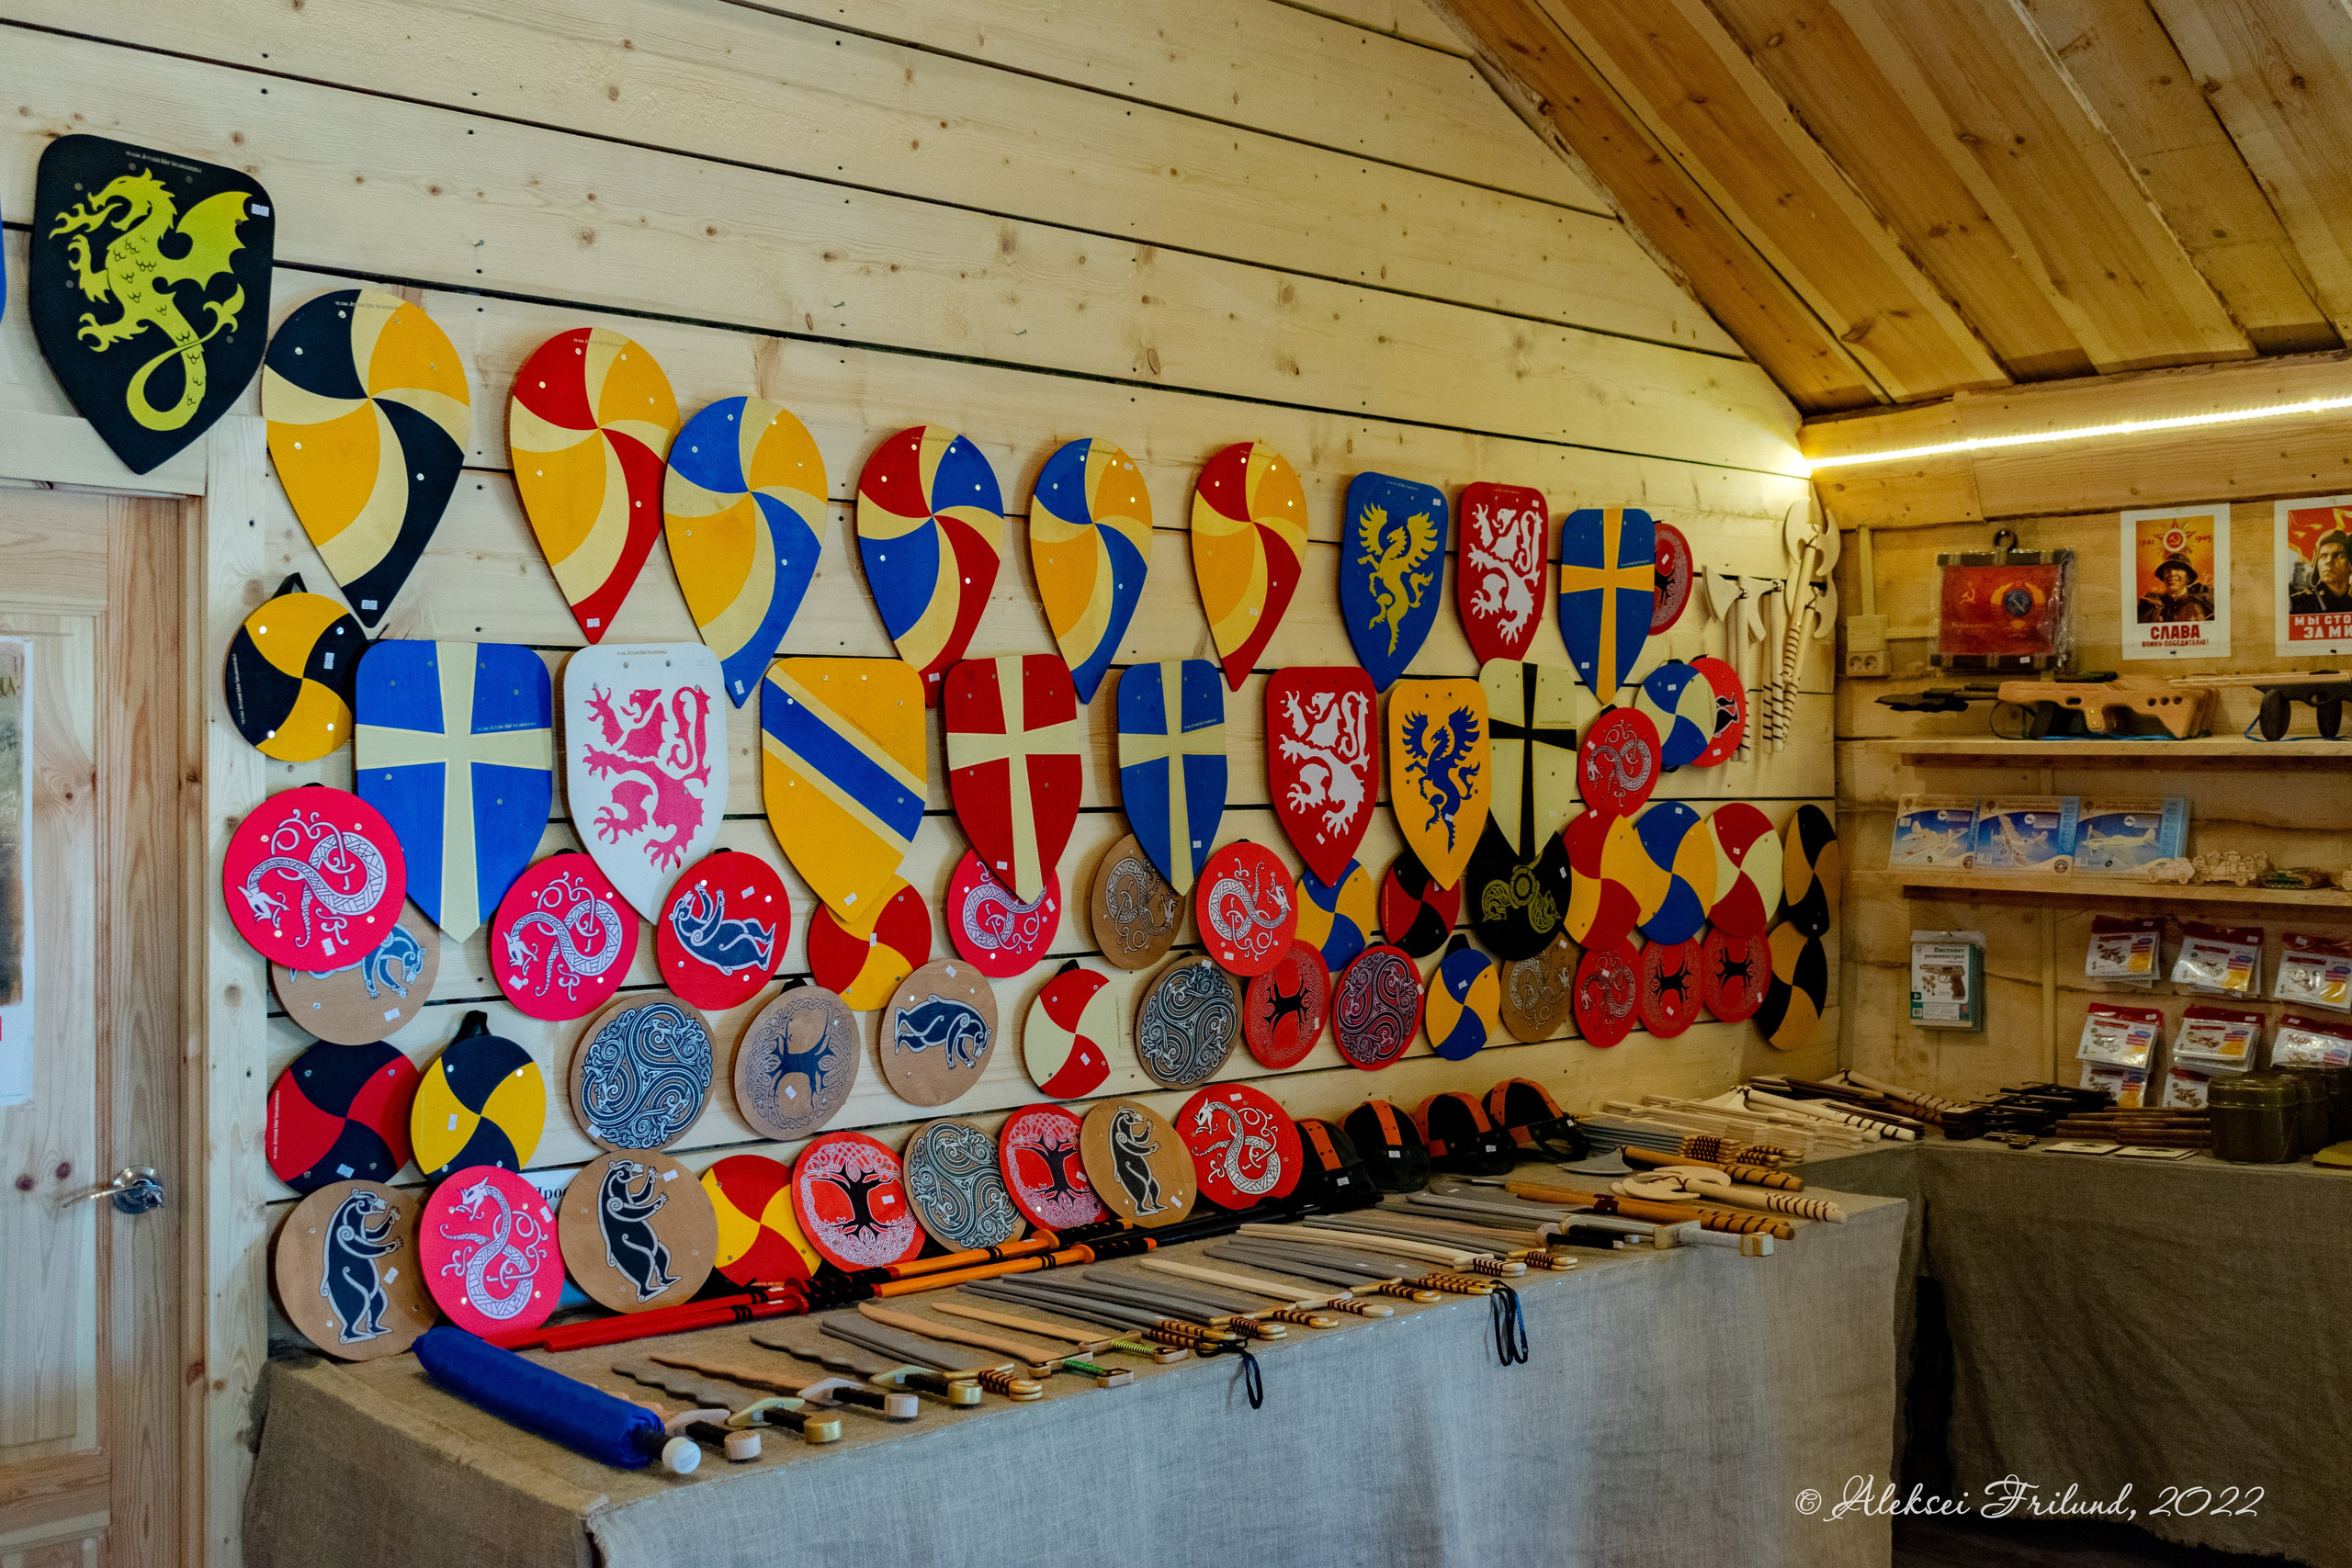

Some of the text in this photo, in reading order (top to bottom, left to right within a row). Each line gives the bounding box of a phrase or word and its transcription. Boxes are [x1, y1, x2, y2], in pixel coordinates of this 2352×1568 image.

[2195, 535, 2212, 543] 1945
[2294, 615, 2320, 626] МЫ
[2150, 625, 2200, 640] СЛАВА
[2303, 626, 2324, 638] ЗА
